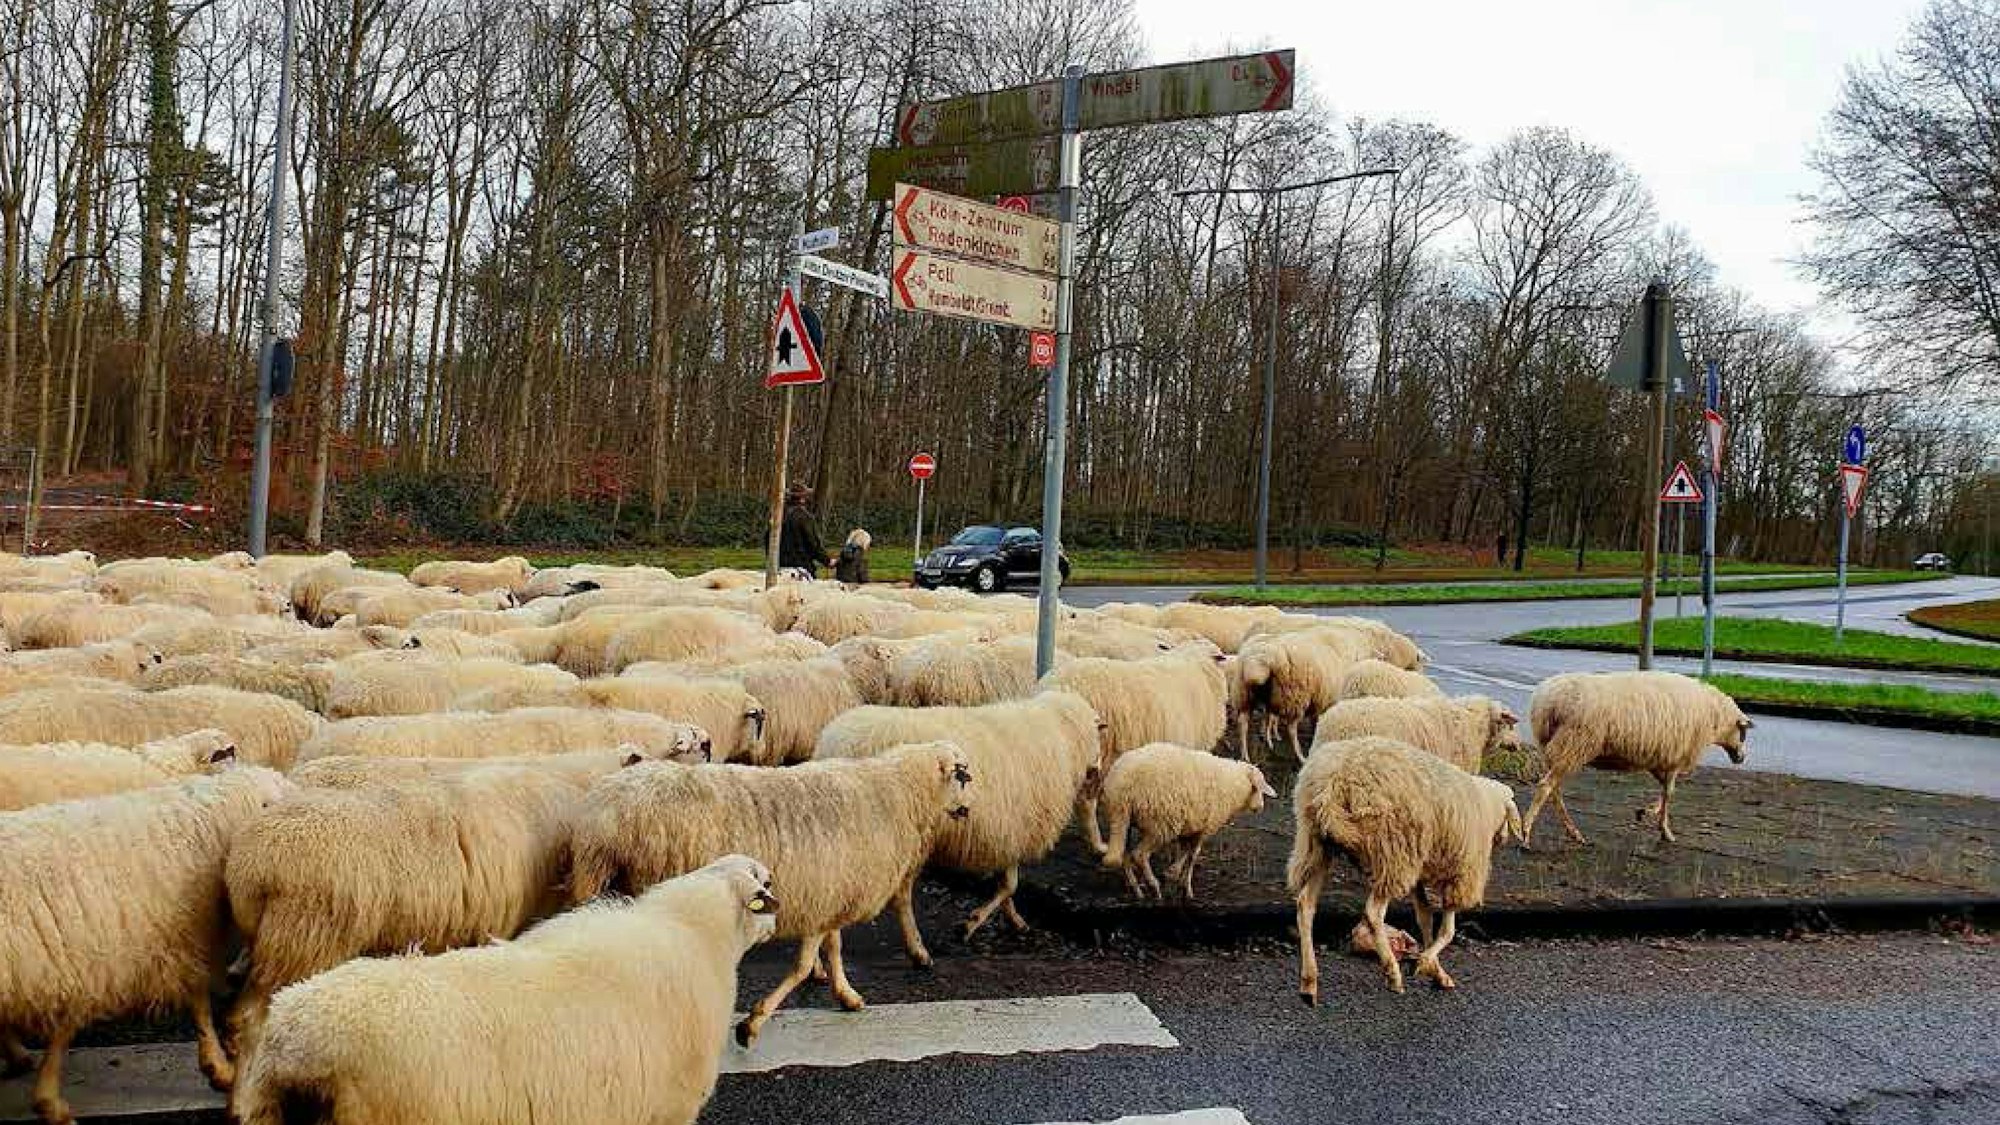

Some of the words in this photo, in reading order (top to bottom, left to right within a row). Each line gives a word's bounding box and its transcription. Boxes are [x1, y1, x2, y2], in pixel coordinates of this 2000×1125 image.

[930, 201, 1024, 237] Köln-Zentrum
[928, 226, 1020, 260] Rodenkirchen
[928, 263, 955, 284] Poll
